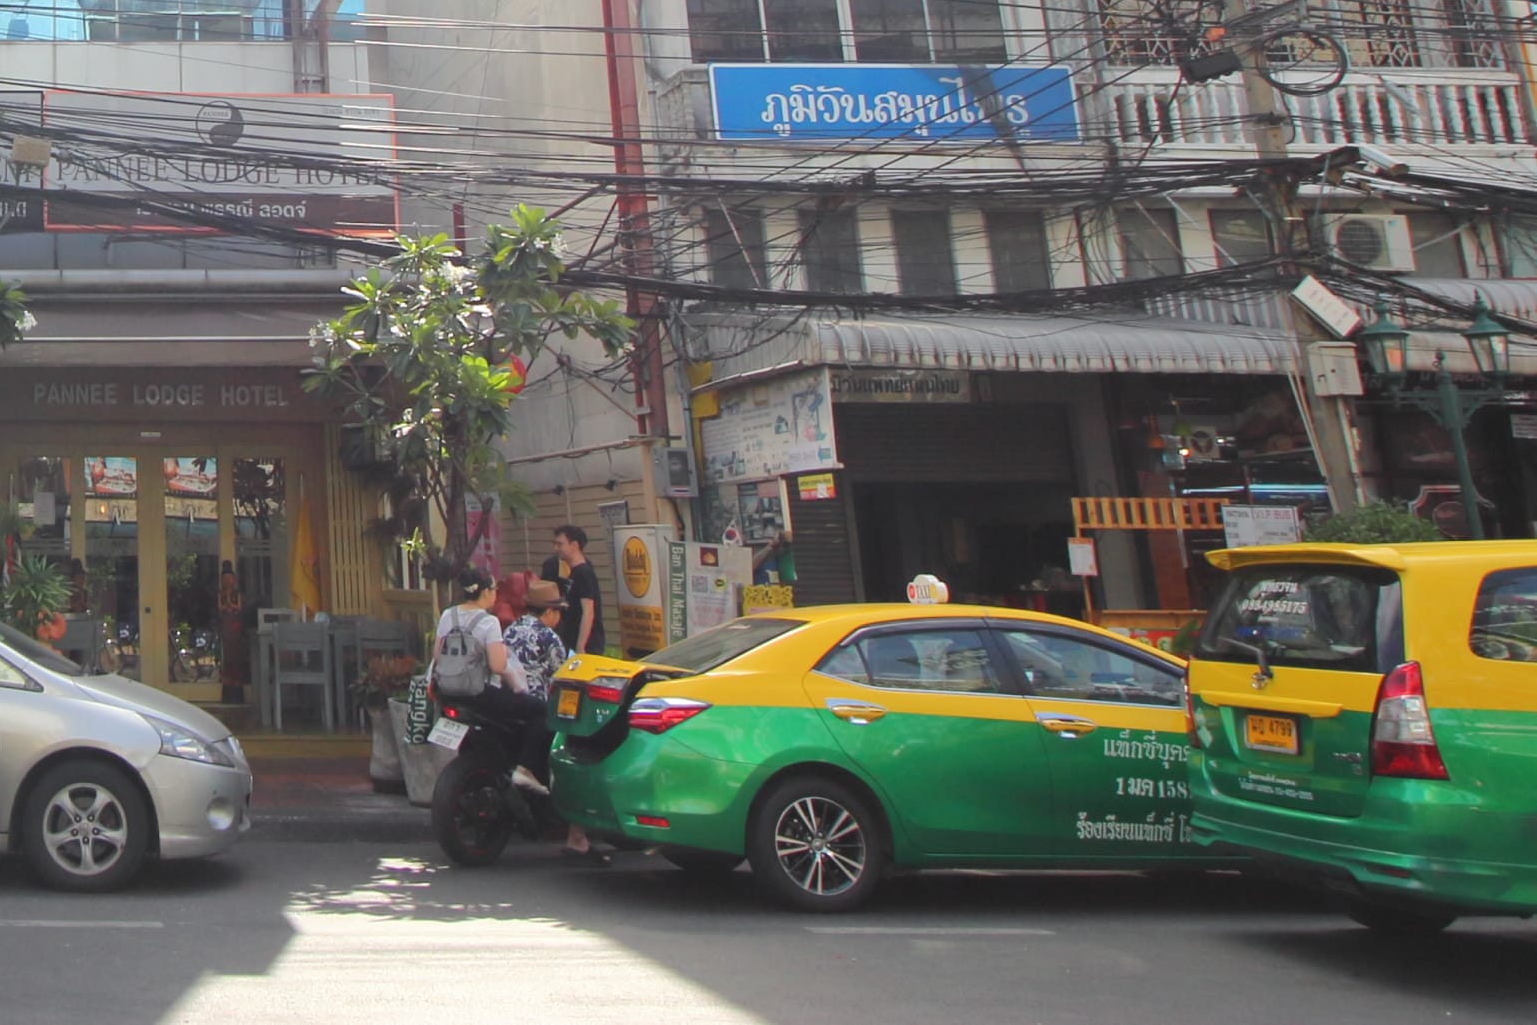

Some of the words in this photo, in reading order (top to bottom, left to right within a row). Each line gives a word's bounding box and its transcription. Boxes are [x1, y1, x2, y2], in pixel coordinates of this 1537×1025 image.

[56, 157, 170, 182] PANNEE
[182, 159, 282, 185] LODGE
[33, 383, 118, 405] PANNEE
[133, 384, 205, 407] LODGE
[220, 385, 290, 407] HOTEL
[671, 545, 685, 567] Ban
[671, 571, 685, 595] Thai
[1157, 779, 1194, 800] 158
